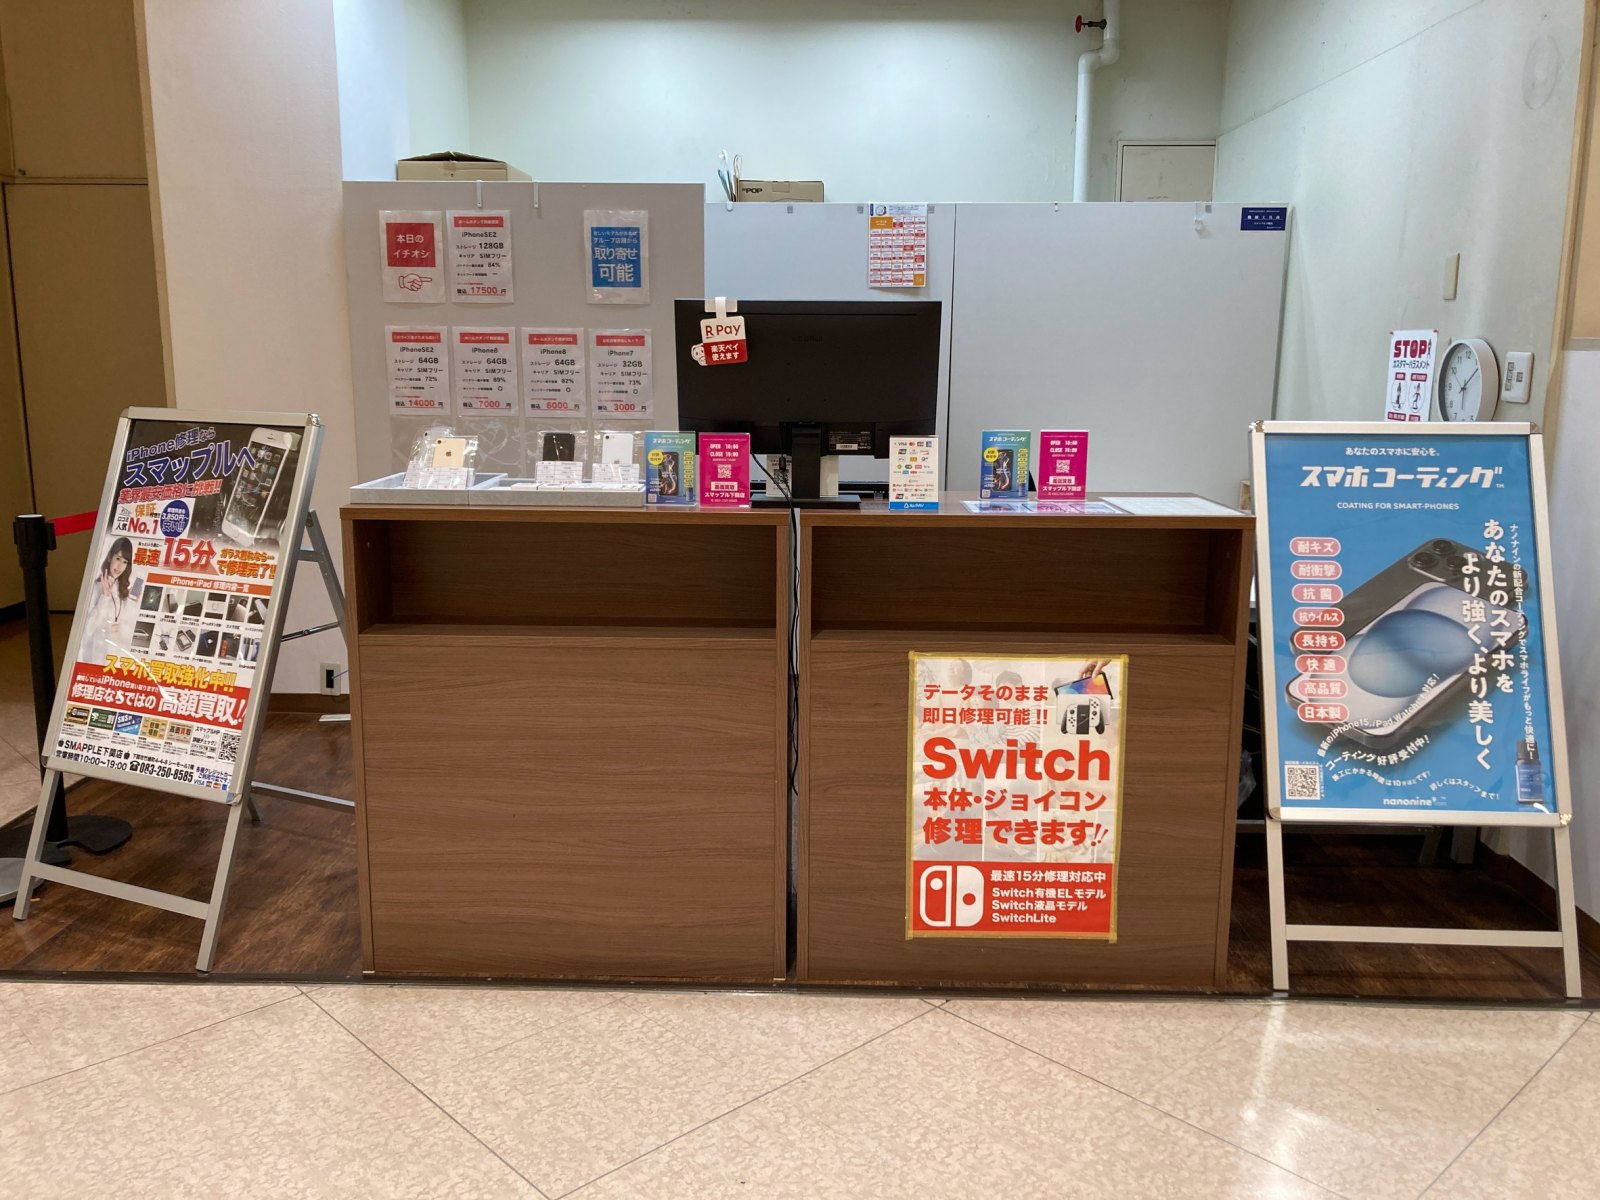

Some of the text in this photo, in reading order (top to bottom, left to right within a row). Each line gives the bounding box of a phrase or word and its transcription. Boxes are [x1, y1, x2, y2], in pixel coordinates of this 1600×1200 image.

[396, 234, 424, 244] 本日の
[393, 250, 430, 258] イチオシ
[594, 248, 638, 260] 取り寄せ
[598, 263, 634, 282] 可能
[705, 325, 741, 339] R Pay
[711, 344, 738, 353] 楽天ペイ
[1394, 340, 1427, 358] STOP
[1466, 351, 1471, 359] 12
[712, 352, 739, 361] 使えます
[126, 427, 216, 462] iPhone修理なら
[1345, 447, 1440, 457] あなたのスマホに安心を。
[124, 440, 256, 486] スマップルへ
[136, 504, 156, 517] 保証
[1337, 502, 1373, 510] COATING
[1393, 503, 1460, 511] SMART-PHONES
[116, 517, 159, 535] 人気 No.1
[1297, 541, 1334, 553] 耐キズ
[133, 538, 216, 571] 最速 15分
[217, 560, 277, 579] で修理完了!!
[1298, 565, 1336, 577] 耐衝撃
[1483, 519, 1514, 694] あなたのスマホを
[1300, 612, 1340, 623] 抗ウイルス
[1302, 635, 1338, 647] 長持ち
[1461, 552, 1493, 772] より強く、より美しく
[103, 654, 237, 692] スマホ買取強化中!!
[72, 682, 156, 709] 修理店ならではの
[924, 684, 1049, 702] データそのまま
[1304, 682, 1342, 695] 高品質
[922, 707, 1048, 725] 即日修理可能!!
[1305, 706, 1341, 719] 日本製
[64, 740, 124, 759] SMAPPLE下関店
[1326, 734, 1430, 770] コーティング好評受付中!
[922, 737, 1110, 781] Switch
[139, 762, 194, 784] 083-250-8585
[924, 787, 1107, 812] 本体・ジョイコン
[1383, 796, 1432, 806] nanonine
[923, 817, 1109, 848] 修理できます!!
[990, 870, 1106, 884] 最速15分修理対応中
[992, 900, 1088, 912] Switch液晶モデル
[992, 912, 1056, 923] SwitchLite
